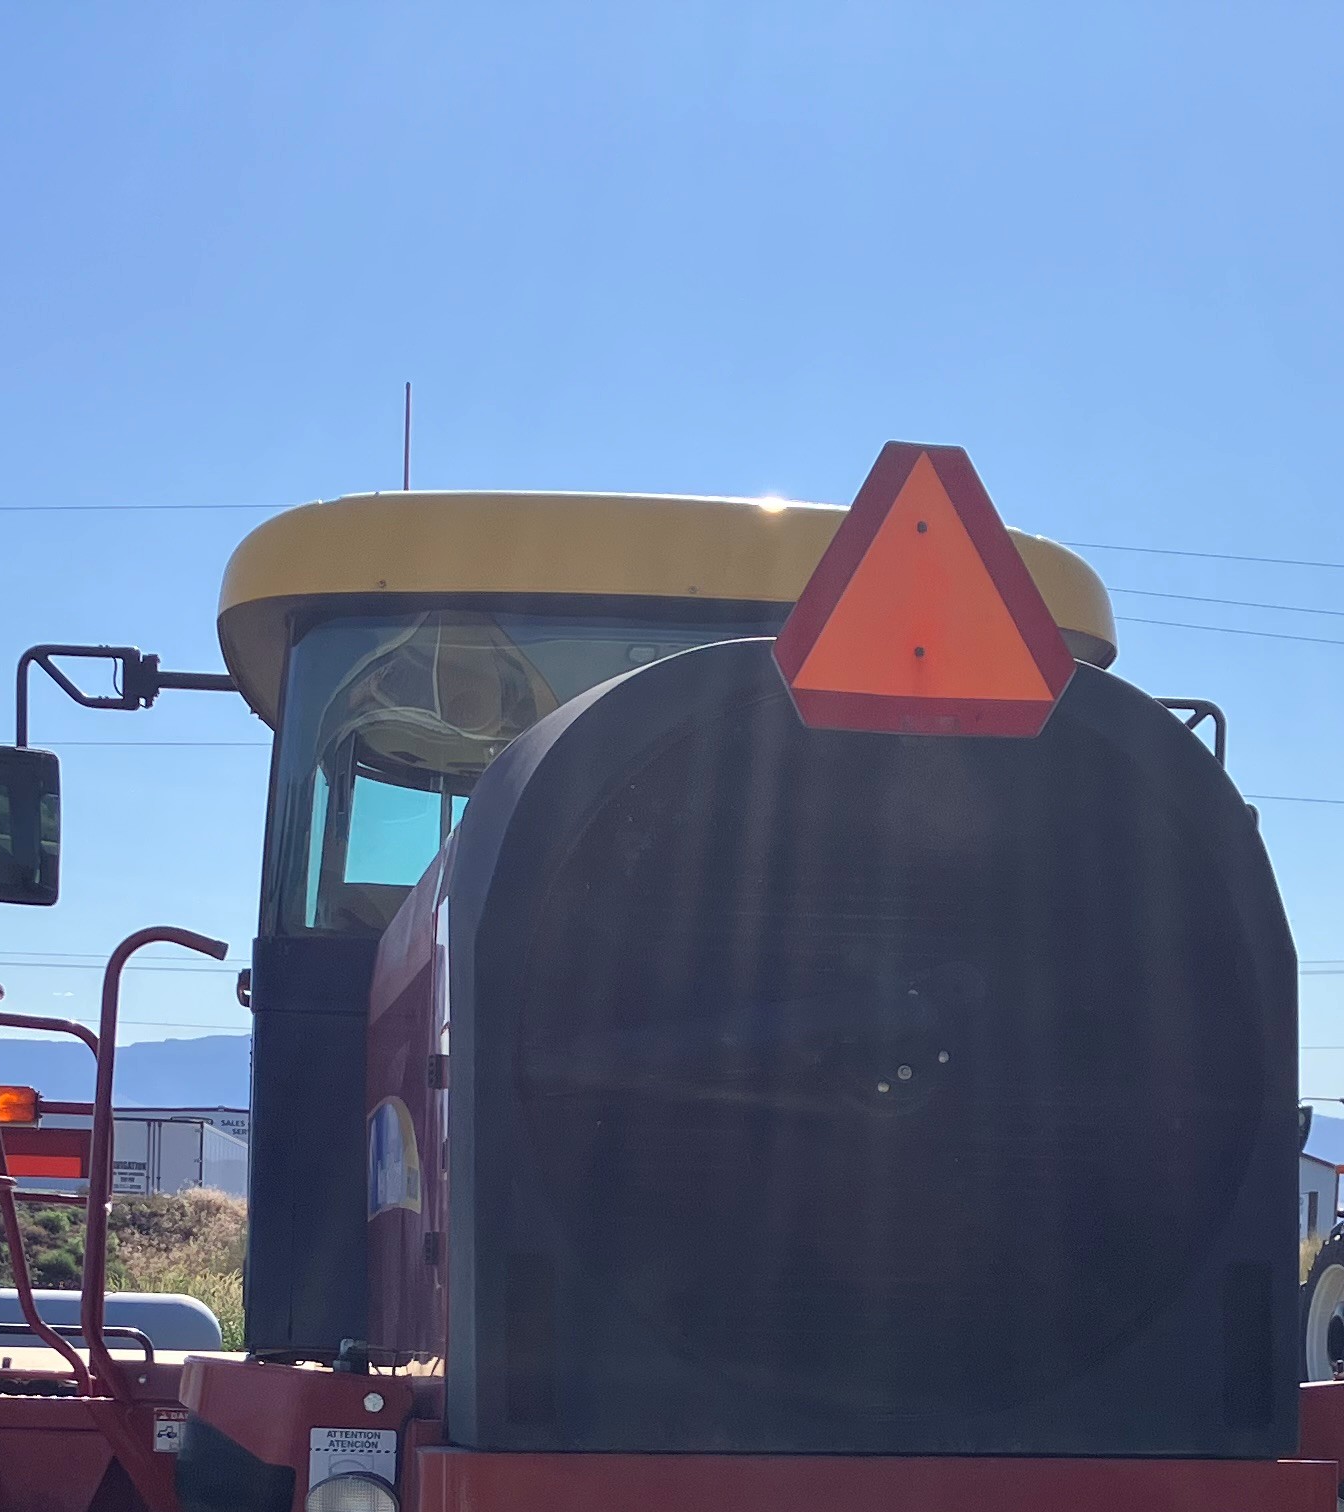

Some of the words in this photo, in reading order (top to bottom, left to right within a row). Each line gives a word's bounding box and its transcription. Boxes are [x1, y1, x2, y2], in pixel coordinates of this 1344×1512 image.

[220, 1119, 246, 1127] SALES
[326, 1430, 381, 1439] ATTENTION
[328, 1439, 379, 1449] ATENCIÓN
